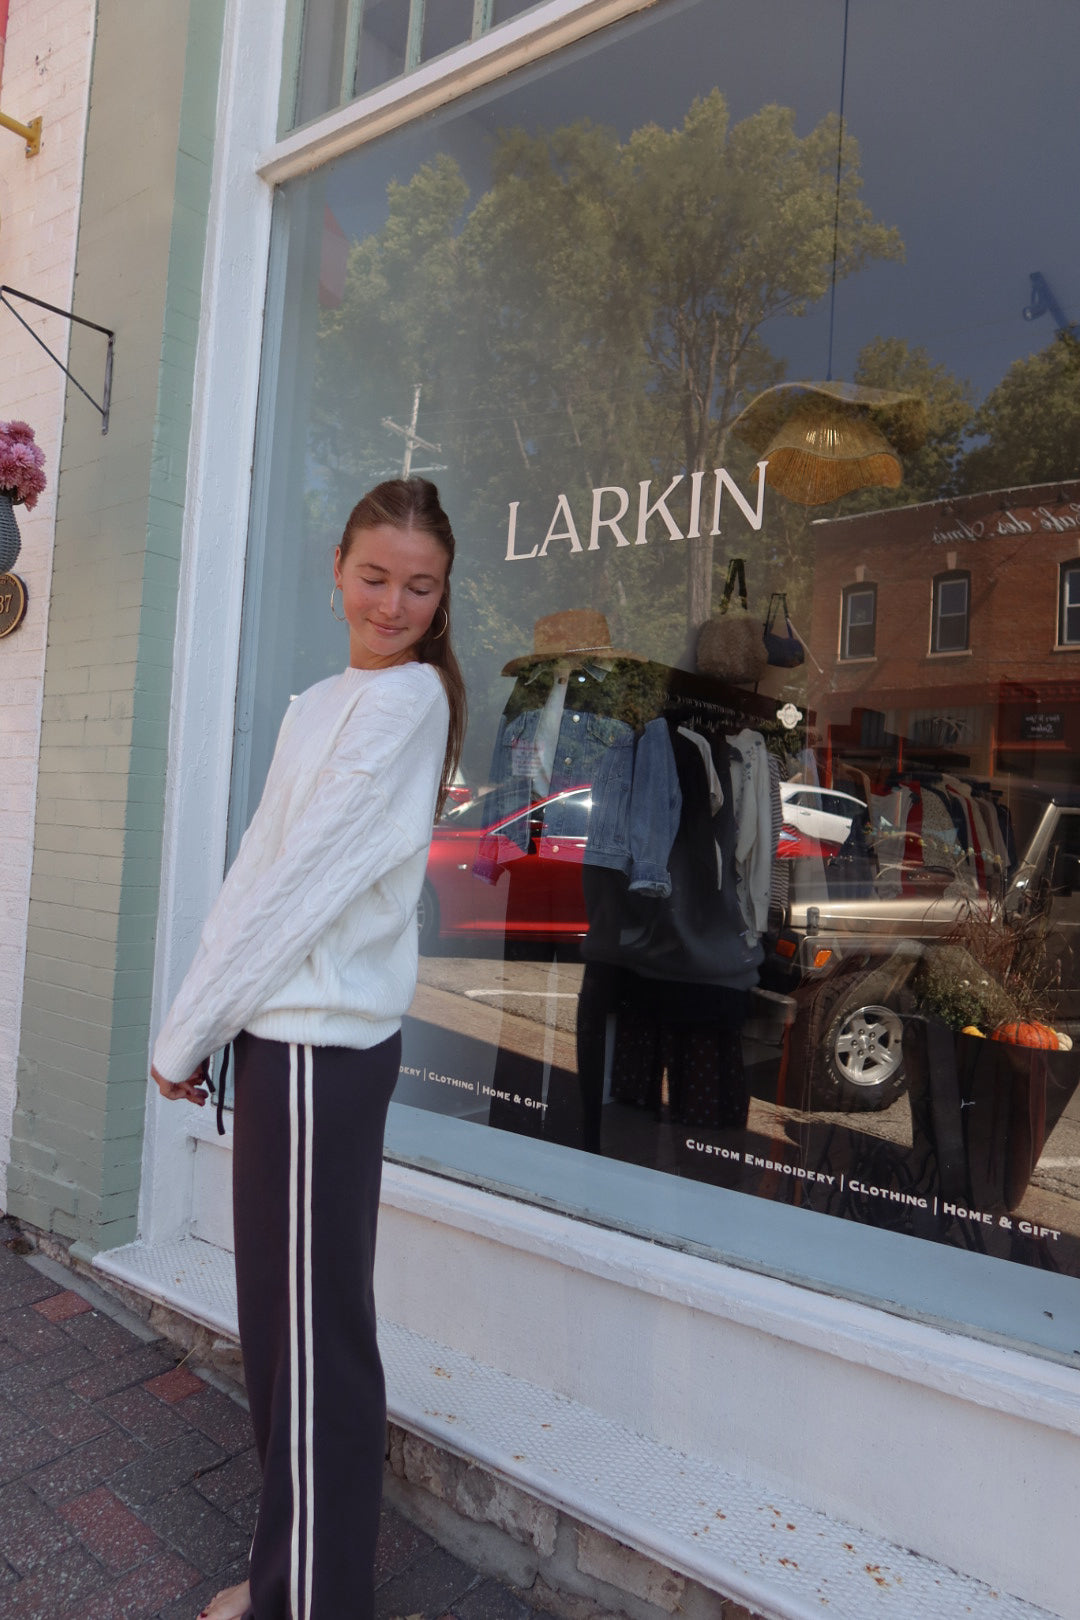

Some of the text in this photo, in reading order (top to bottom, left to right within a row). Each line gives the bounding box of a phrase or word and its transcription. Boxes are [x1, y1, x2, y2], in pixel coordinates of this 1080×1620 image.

[504, 460, 770, 561] LARKIN
[428, 1071, 474, 1092] CLOTHING
[482, 1086, 511, 1102] HOME
[513, 1093, 522, 1103] &
[524, 1097, 549, 1111] GIFT
[686, 1138, 1061, 1241] CUSTOM EMBROIDERY CLOTHING HOME & GIFT
